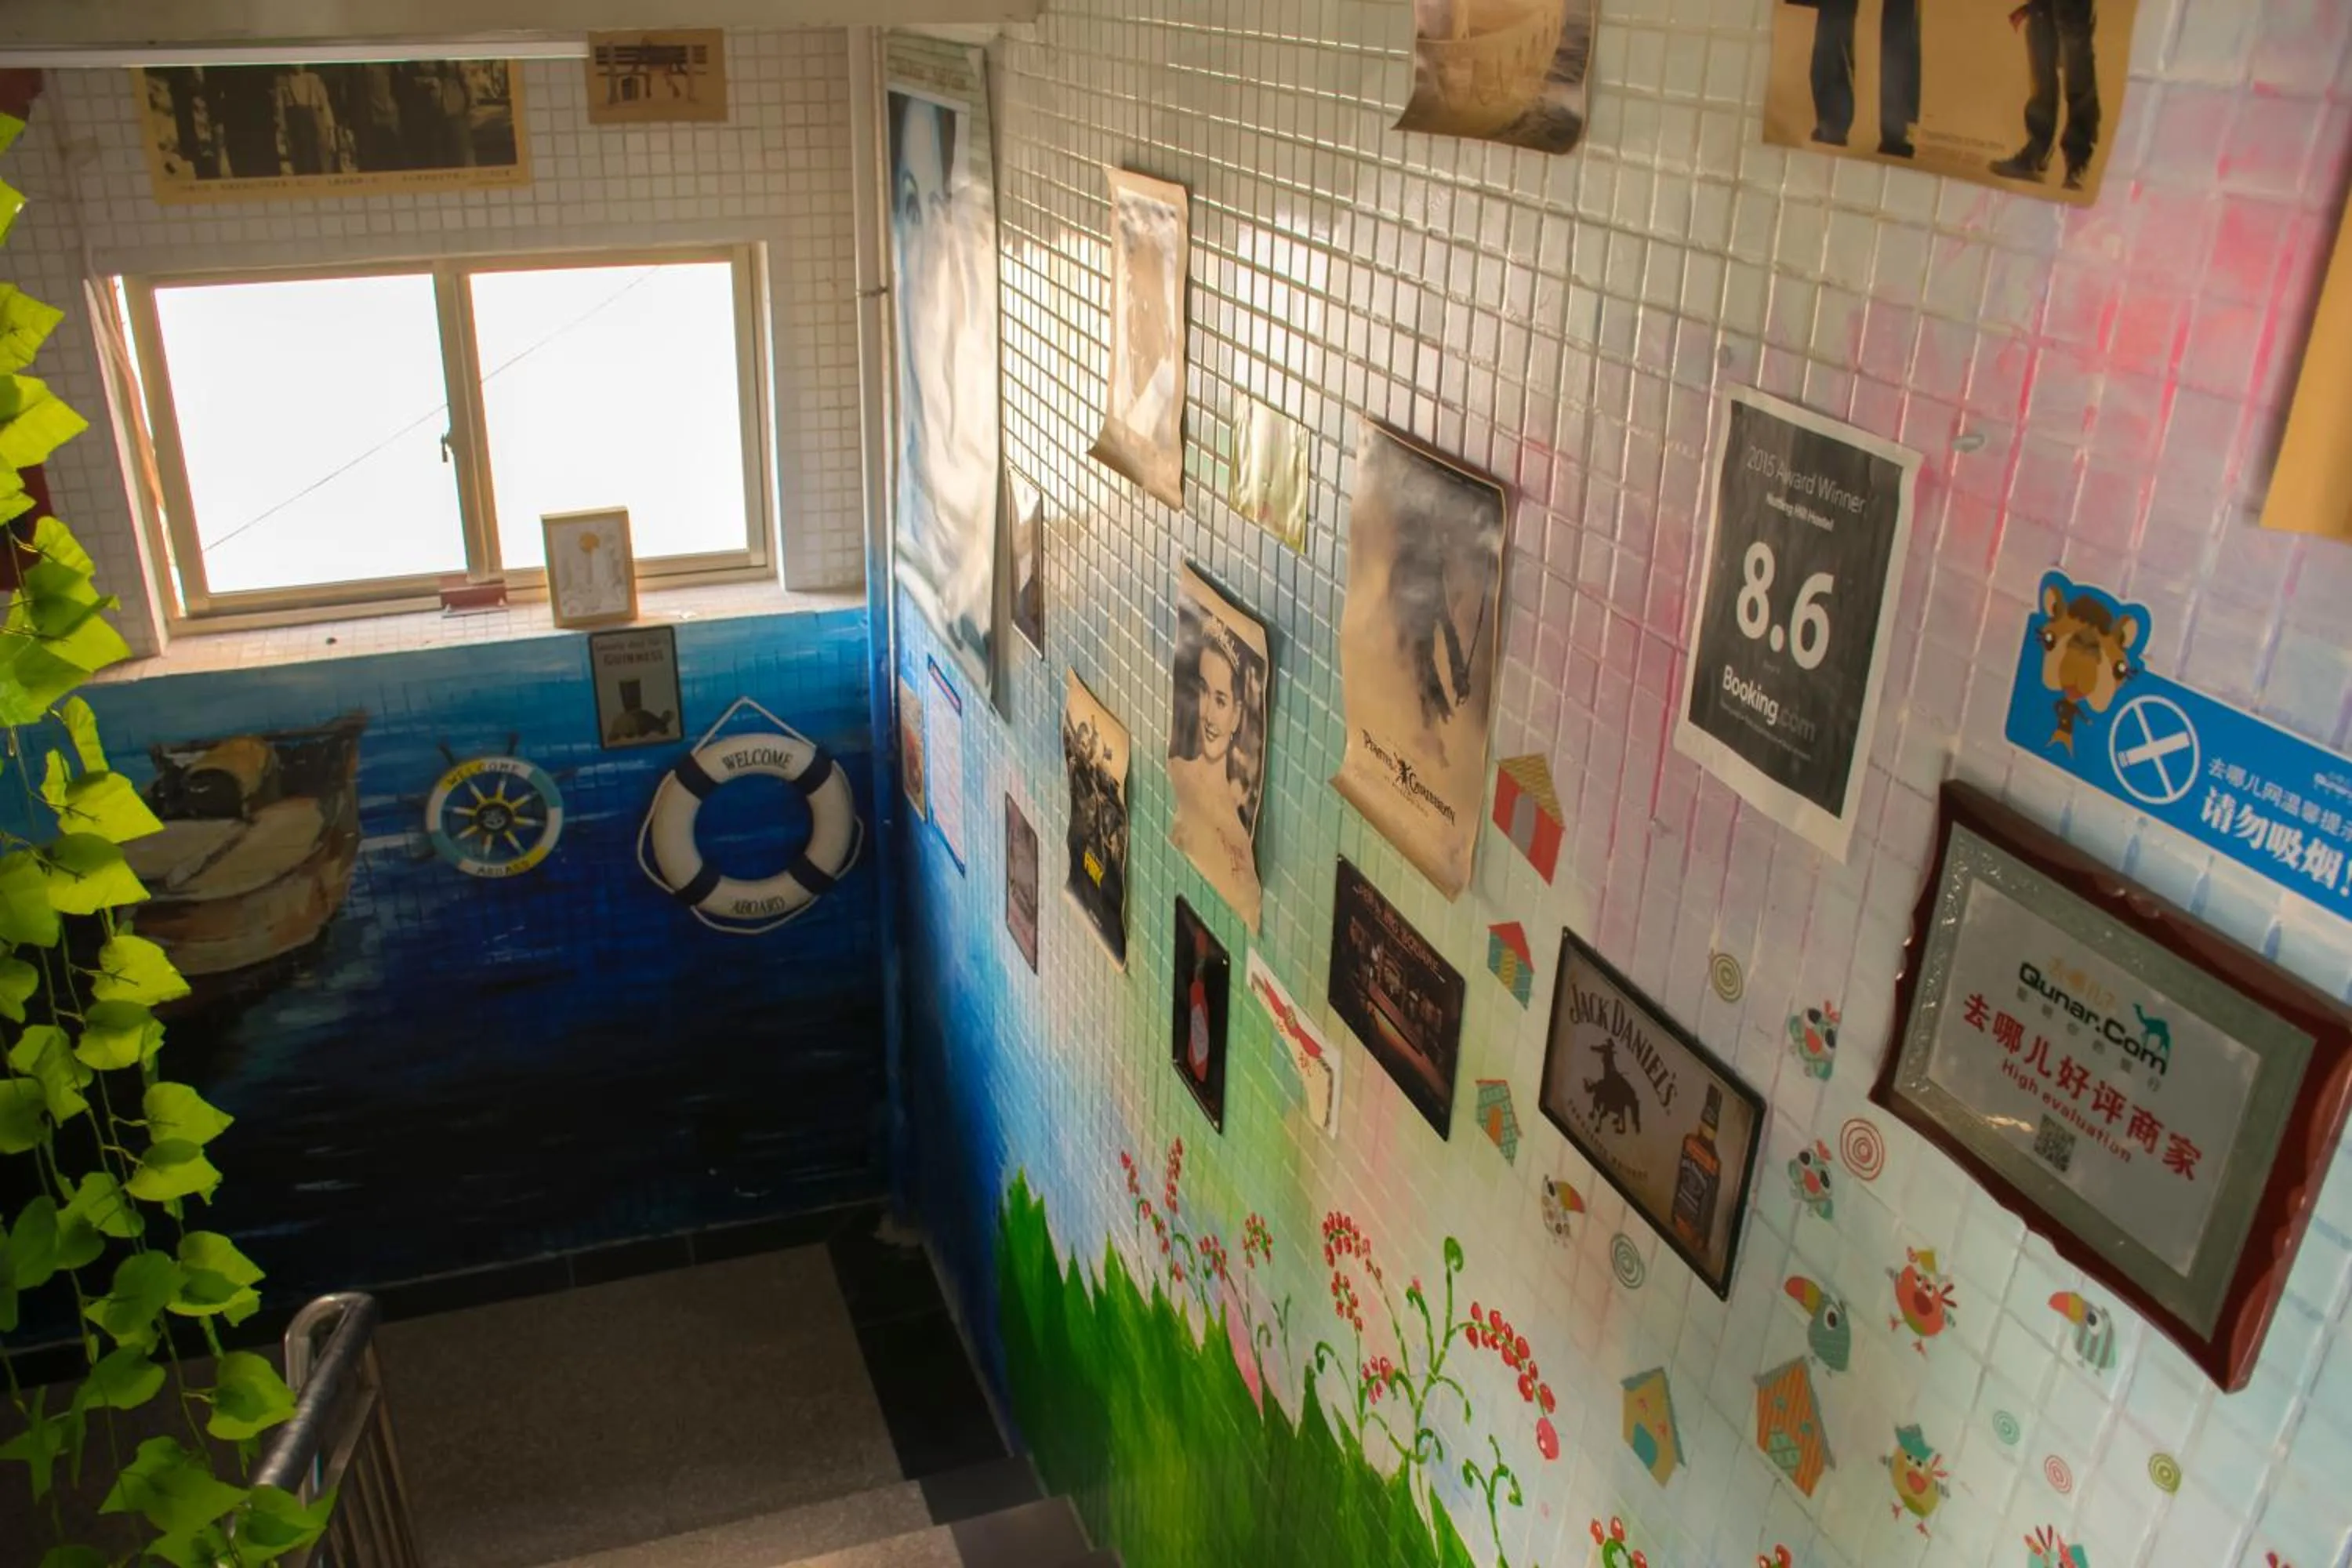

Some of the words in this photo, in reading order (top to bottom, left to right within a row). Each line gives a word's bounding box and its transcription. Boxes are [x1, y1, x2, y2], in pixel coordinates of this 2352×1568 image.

[1818, 475, 1866, 514] Winner
[1737, 542, 1835, 670] 8.6
[721, 748, 793, 771] WELCOME
[731, 896, 786, 915] ABOARD
[1570, 983, 1609, 1030] JACK
[1612, 998, 1678, 1108] DANIEL'S
[2019, 961, 2168, 1076] Qunar.Com
[1963, 993, 2202, 1181] 去哪儿好评商家
[2002, 1058, 2039, 1096] High
[2041, 1091, 2132, 1163] evaluation
